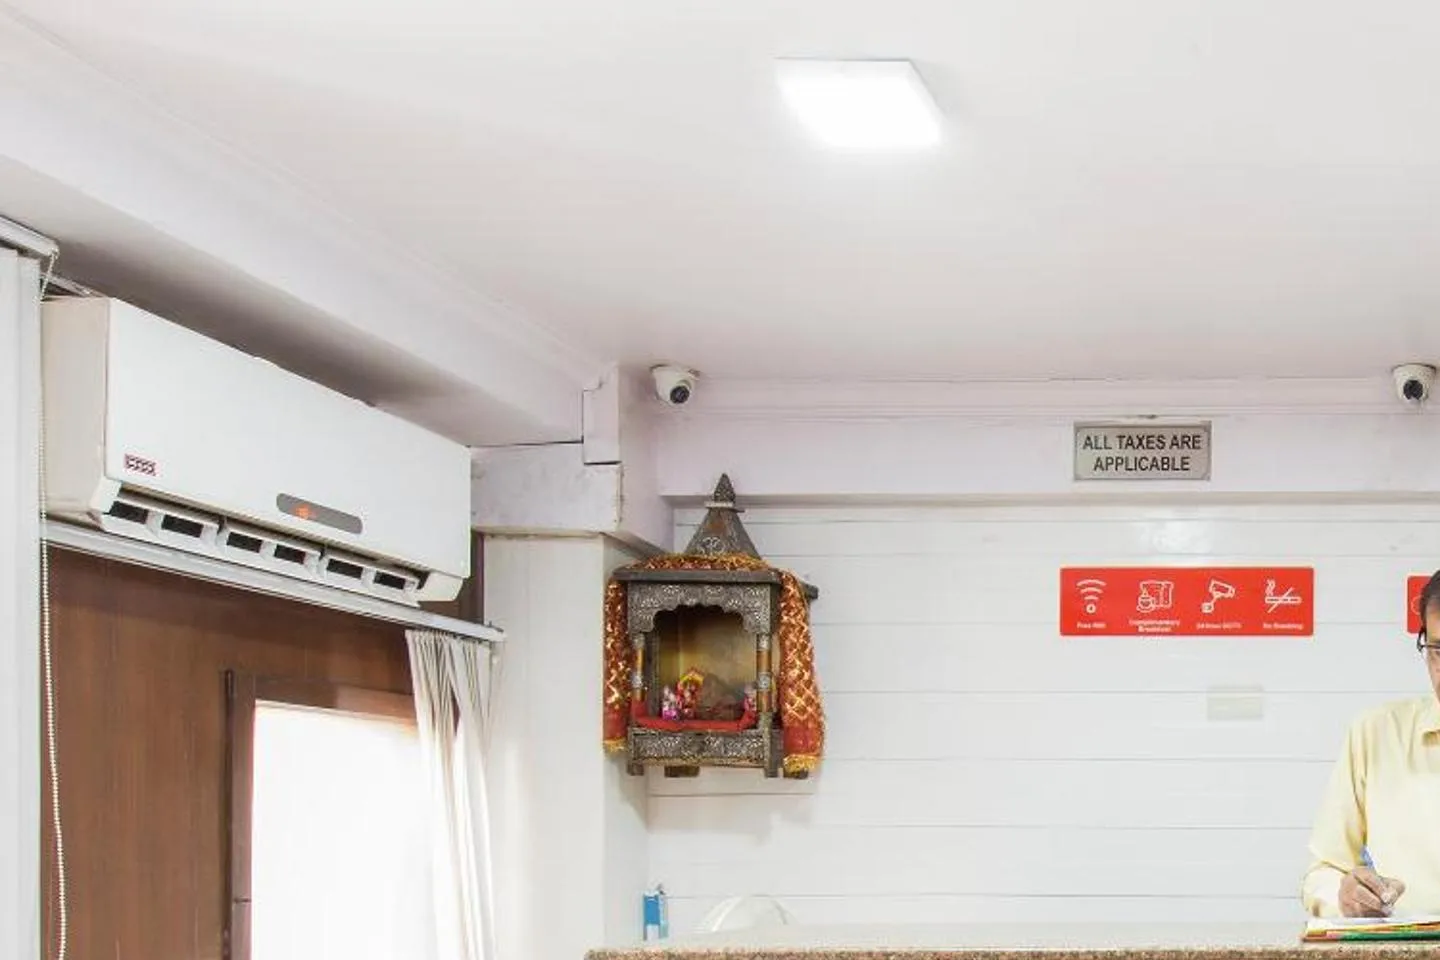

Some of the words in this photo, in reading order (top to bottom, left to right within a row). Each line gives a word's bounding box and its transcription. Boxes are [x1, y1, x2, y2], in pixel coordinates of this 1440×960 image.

[1083, 434, 1112, 450] ALL
[1117, 434, 1166, 450] TAXES
[1169, 434, 1201, 450] ARE
[1093, 455, 1191, 472] APPLICABLE
